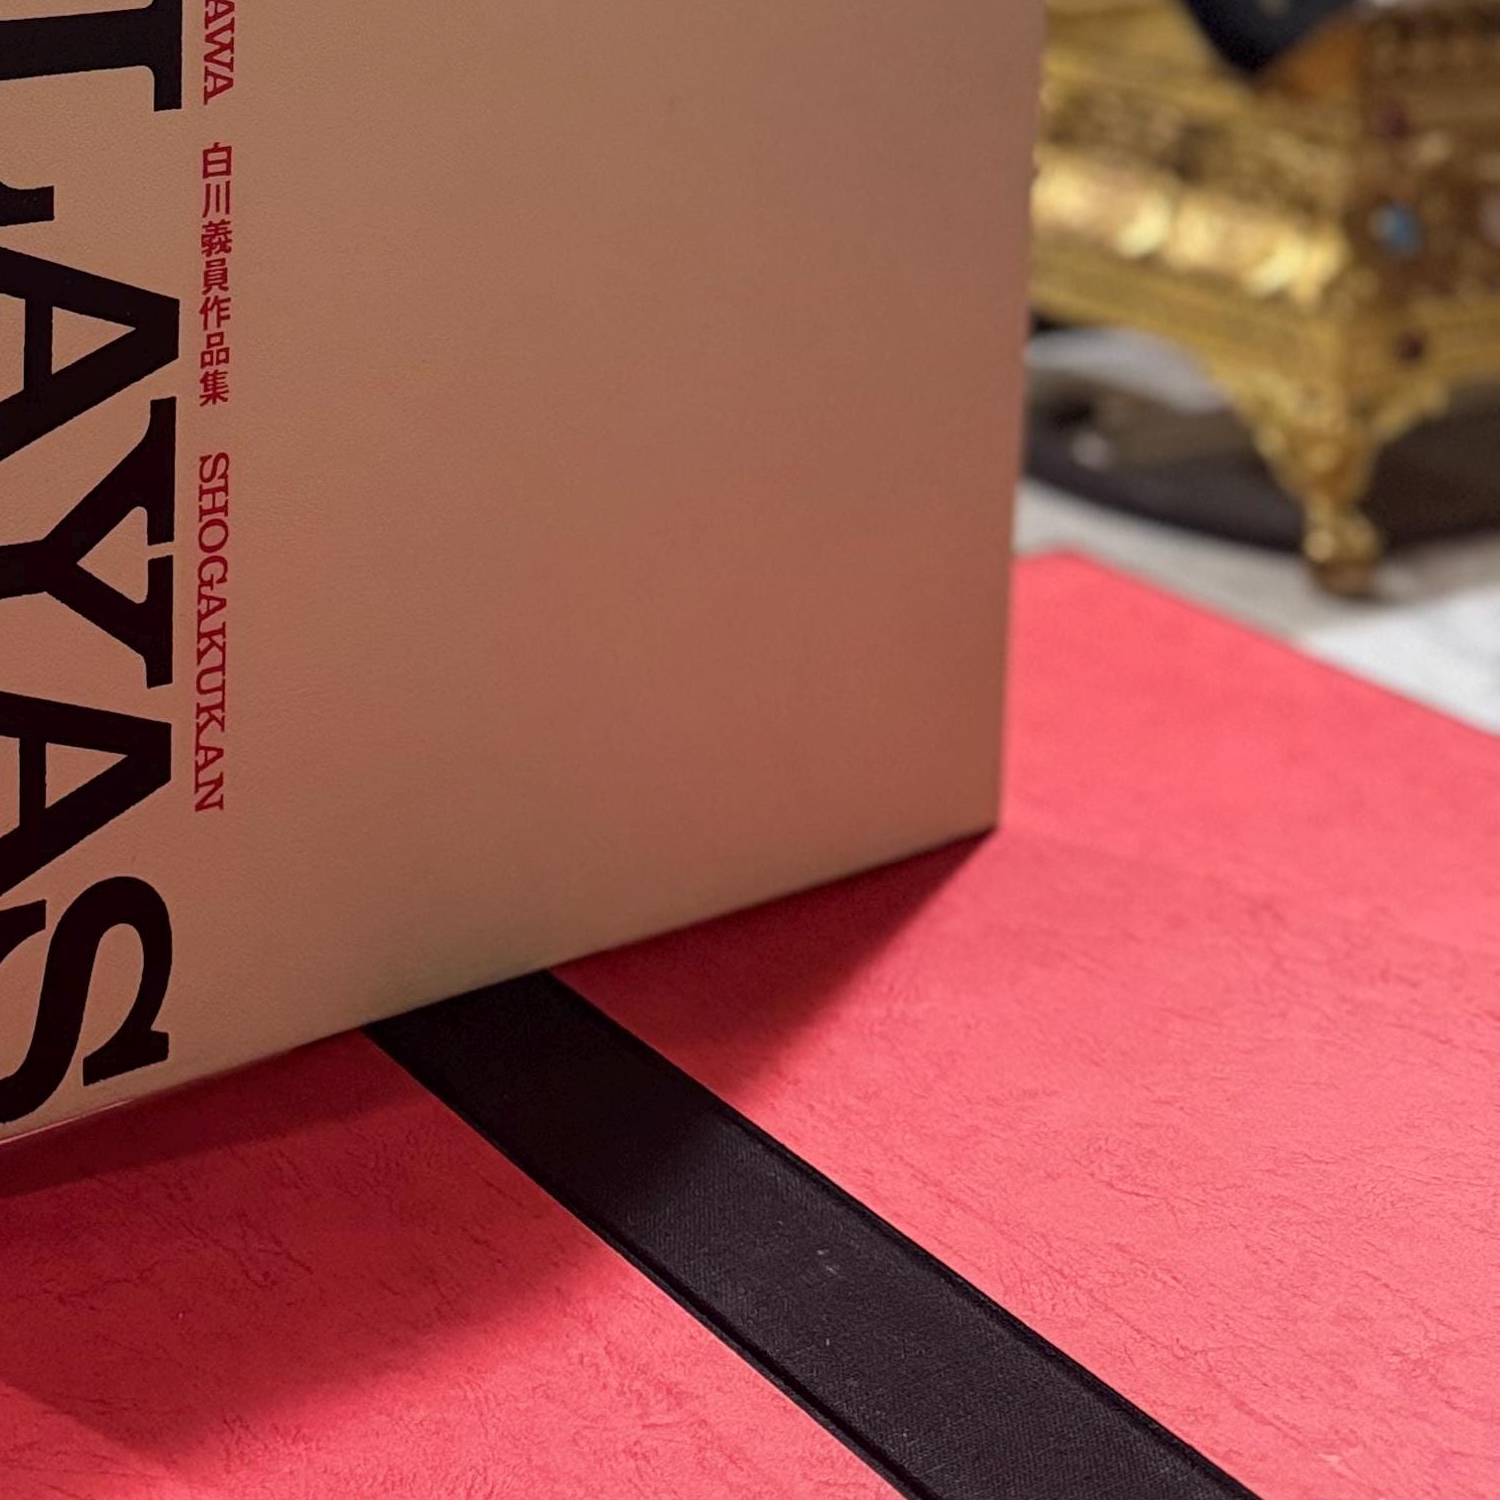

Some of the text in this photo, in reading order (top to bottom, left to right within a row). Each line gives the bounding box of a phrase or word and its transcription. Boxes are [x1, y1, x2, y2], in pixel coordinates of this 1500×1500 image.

[199, 141, 234, 408] 白川義員作品集
[193, 451, 231, 813] SHOGAKUKAN
